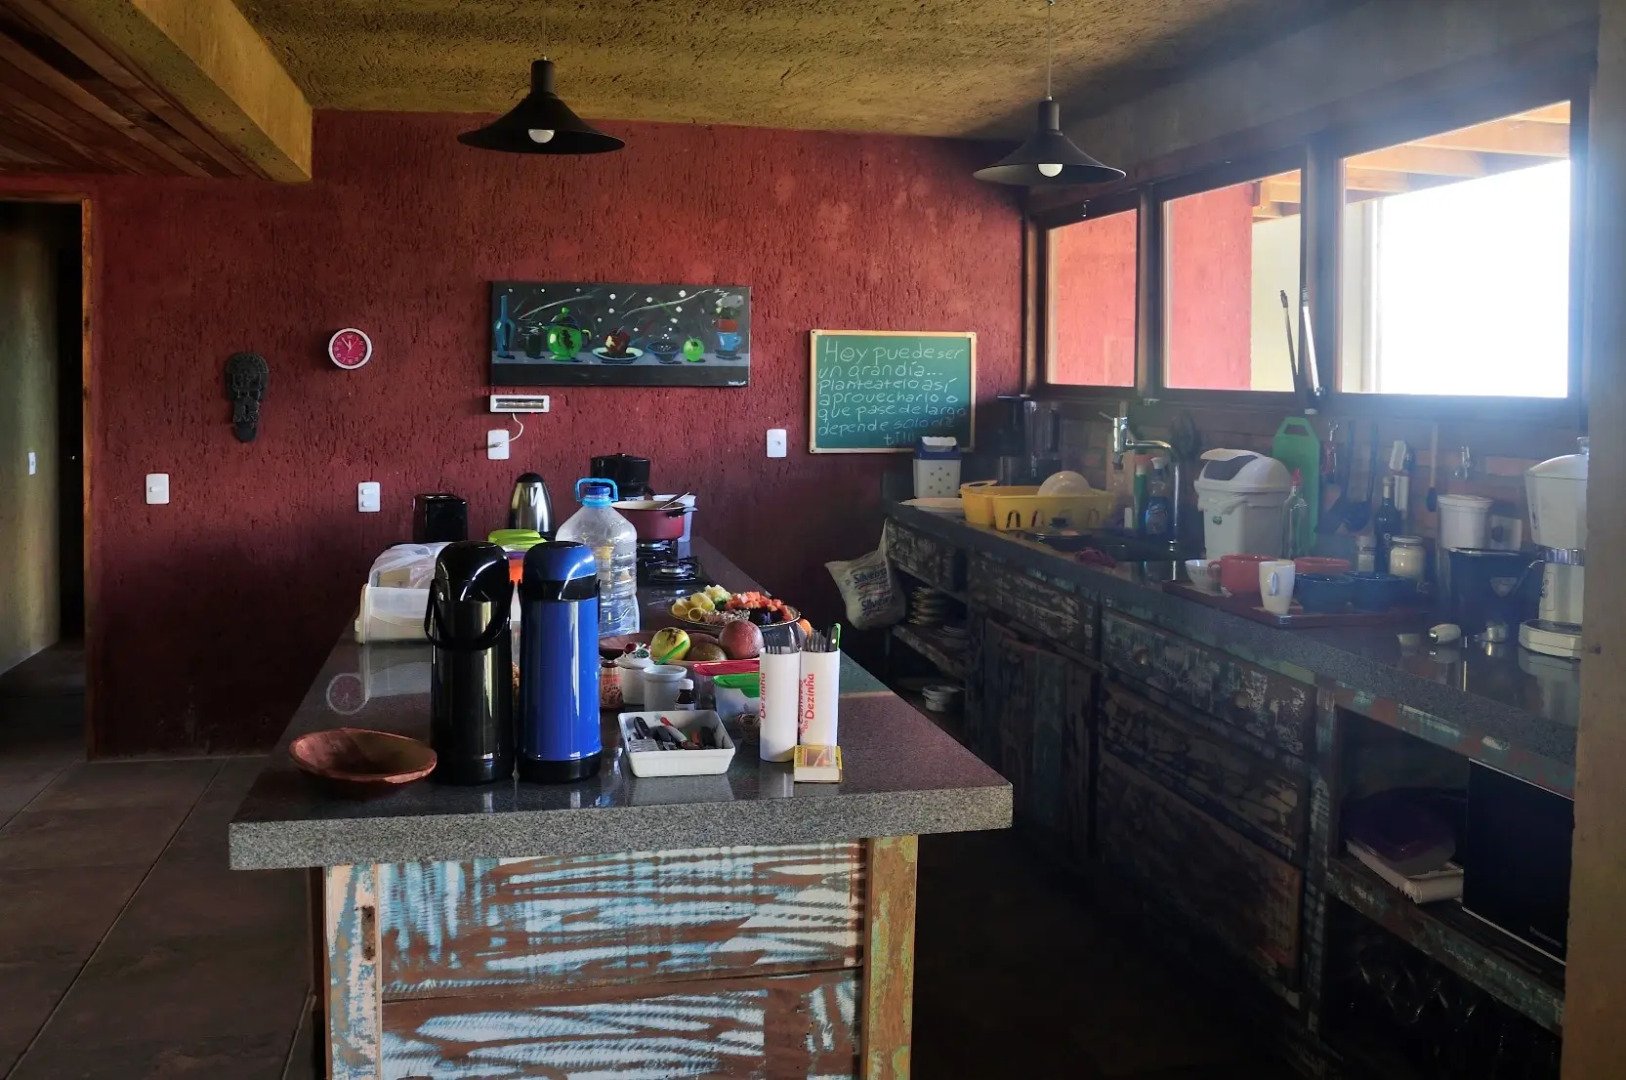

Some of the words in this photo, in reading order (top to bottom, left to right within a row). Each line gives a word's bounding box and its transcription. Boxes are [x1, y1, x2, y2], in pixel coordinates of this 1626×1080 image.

[824, 338, 868, 364] Hoy
[873, 342, 935, 365] puede
[937, 348, 964, 360] ser
[818, 366, 842, 379] un
[848, 365, 892, 380] gran
[946, 395, 959, 404] o
[818, 406, 851, 423] que
[856, 404, 895, 422] pase
[899, 404, 921, 414] de
[925, 404, 966, 418] largo
[818, 419, 889, 437] depende
[893, 418, 929, 430] solo
[804, 673, 815, 720] Dezinha
